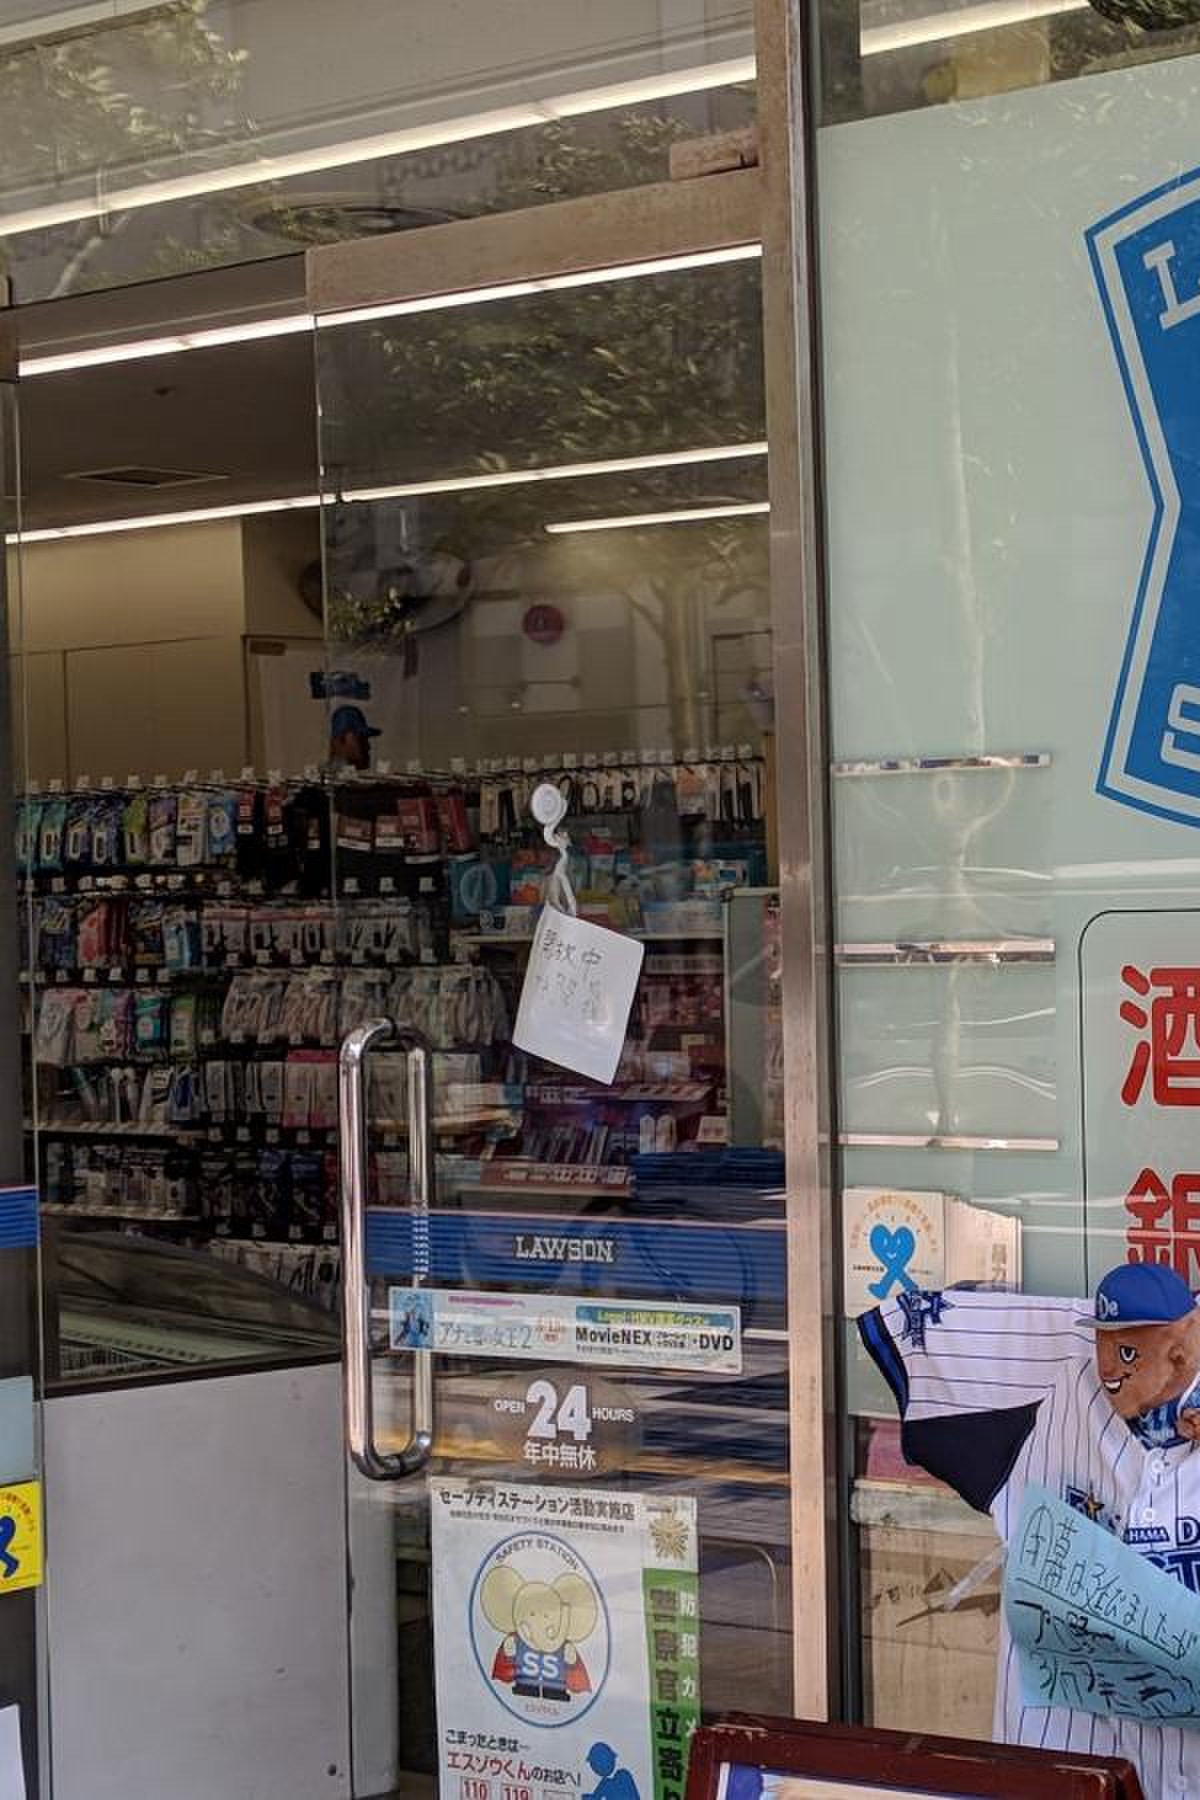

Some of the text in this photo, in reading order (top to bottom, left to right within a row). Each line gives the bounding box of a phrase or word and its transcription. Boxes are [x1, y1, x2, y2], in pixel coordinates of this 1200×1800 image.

[515, 1235, 614, 1263] LAWSON
[575, 1325, 652, 1346] MovieNEX
[494, 1379, 636, 1441] OPEN 24 HOURS
[523, 1440, 597, 1470] 年中無休
[495, 1537, 580, 1571] SAFETY STATION
[522, 1651, 559, 1679] SS
